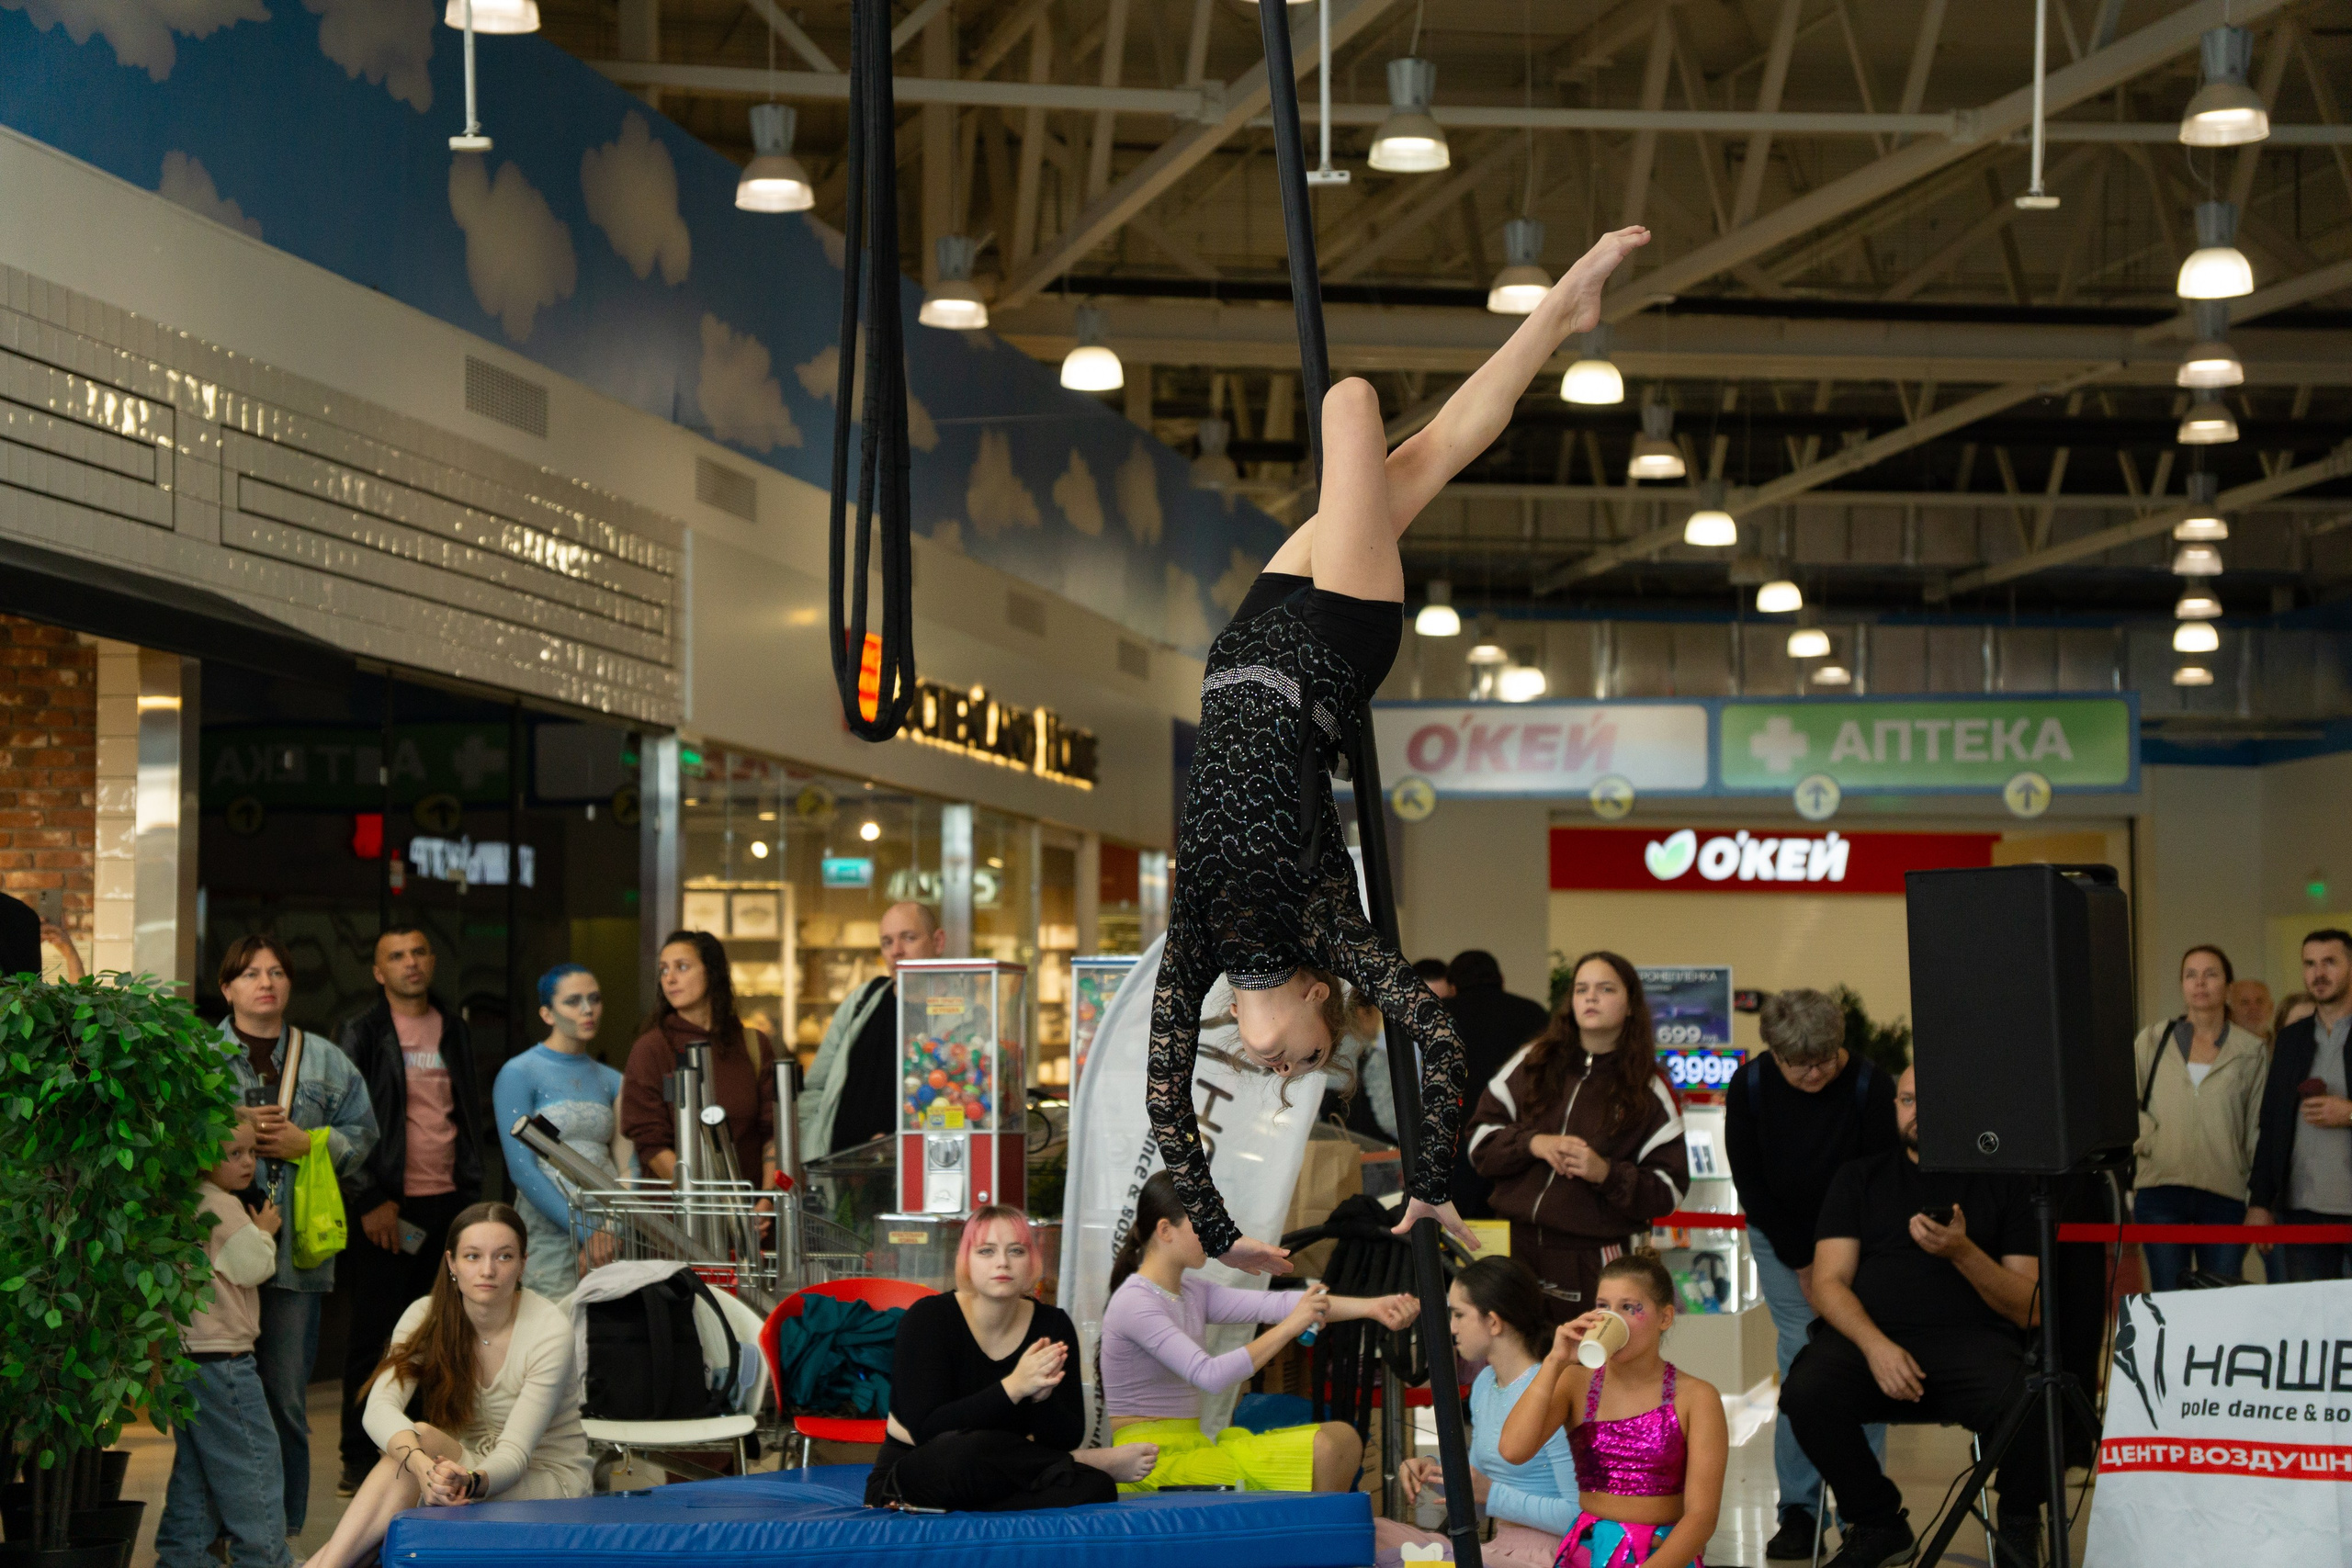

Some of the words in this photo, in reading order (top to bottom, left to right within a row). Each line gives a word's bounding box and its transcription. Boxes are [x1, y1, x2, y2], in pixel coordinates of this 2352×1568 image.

[1830, 716, 2074, 763] АПТЕКА
[1657, 1024, 1702, 1044] 699
[2181, 1398, 2220, 1419] pole
[2228, 1400, 2298, 1421] dance
[2303, 1404, 2318, 1422] &
[2101, 1445, 2185, 1467] ЦЕНТР
[2189, 1447, 2352, 1472] ВОЗДУШН
